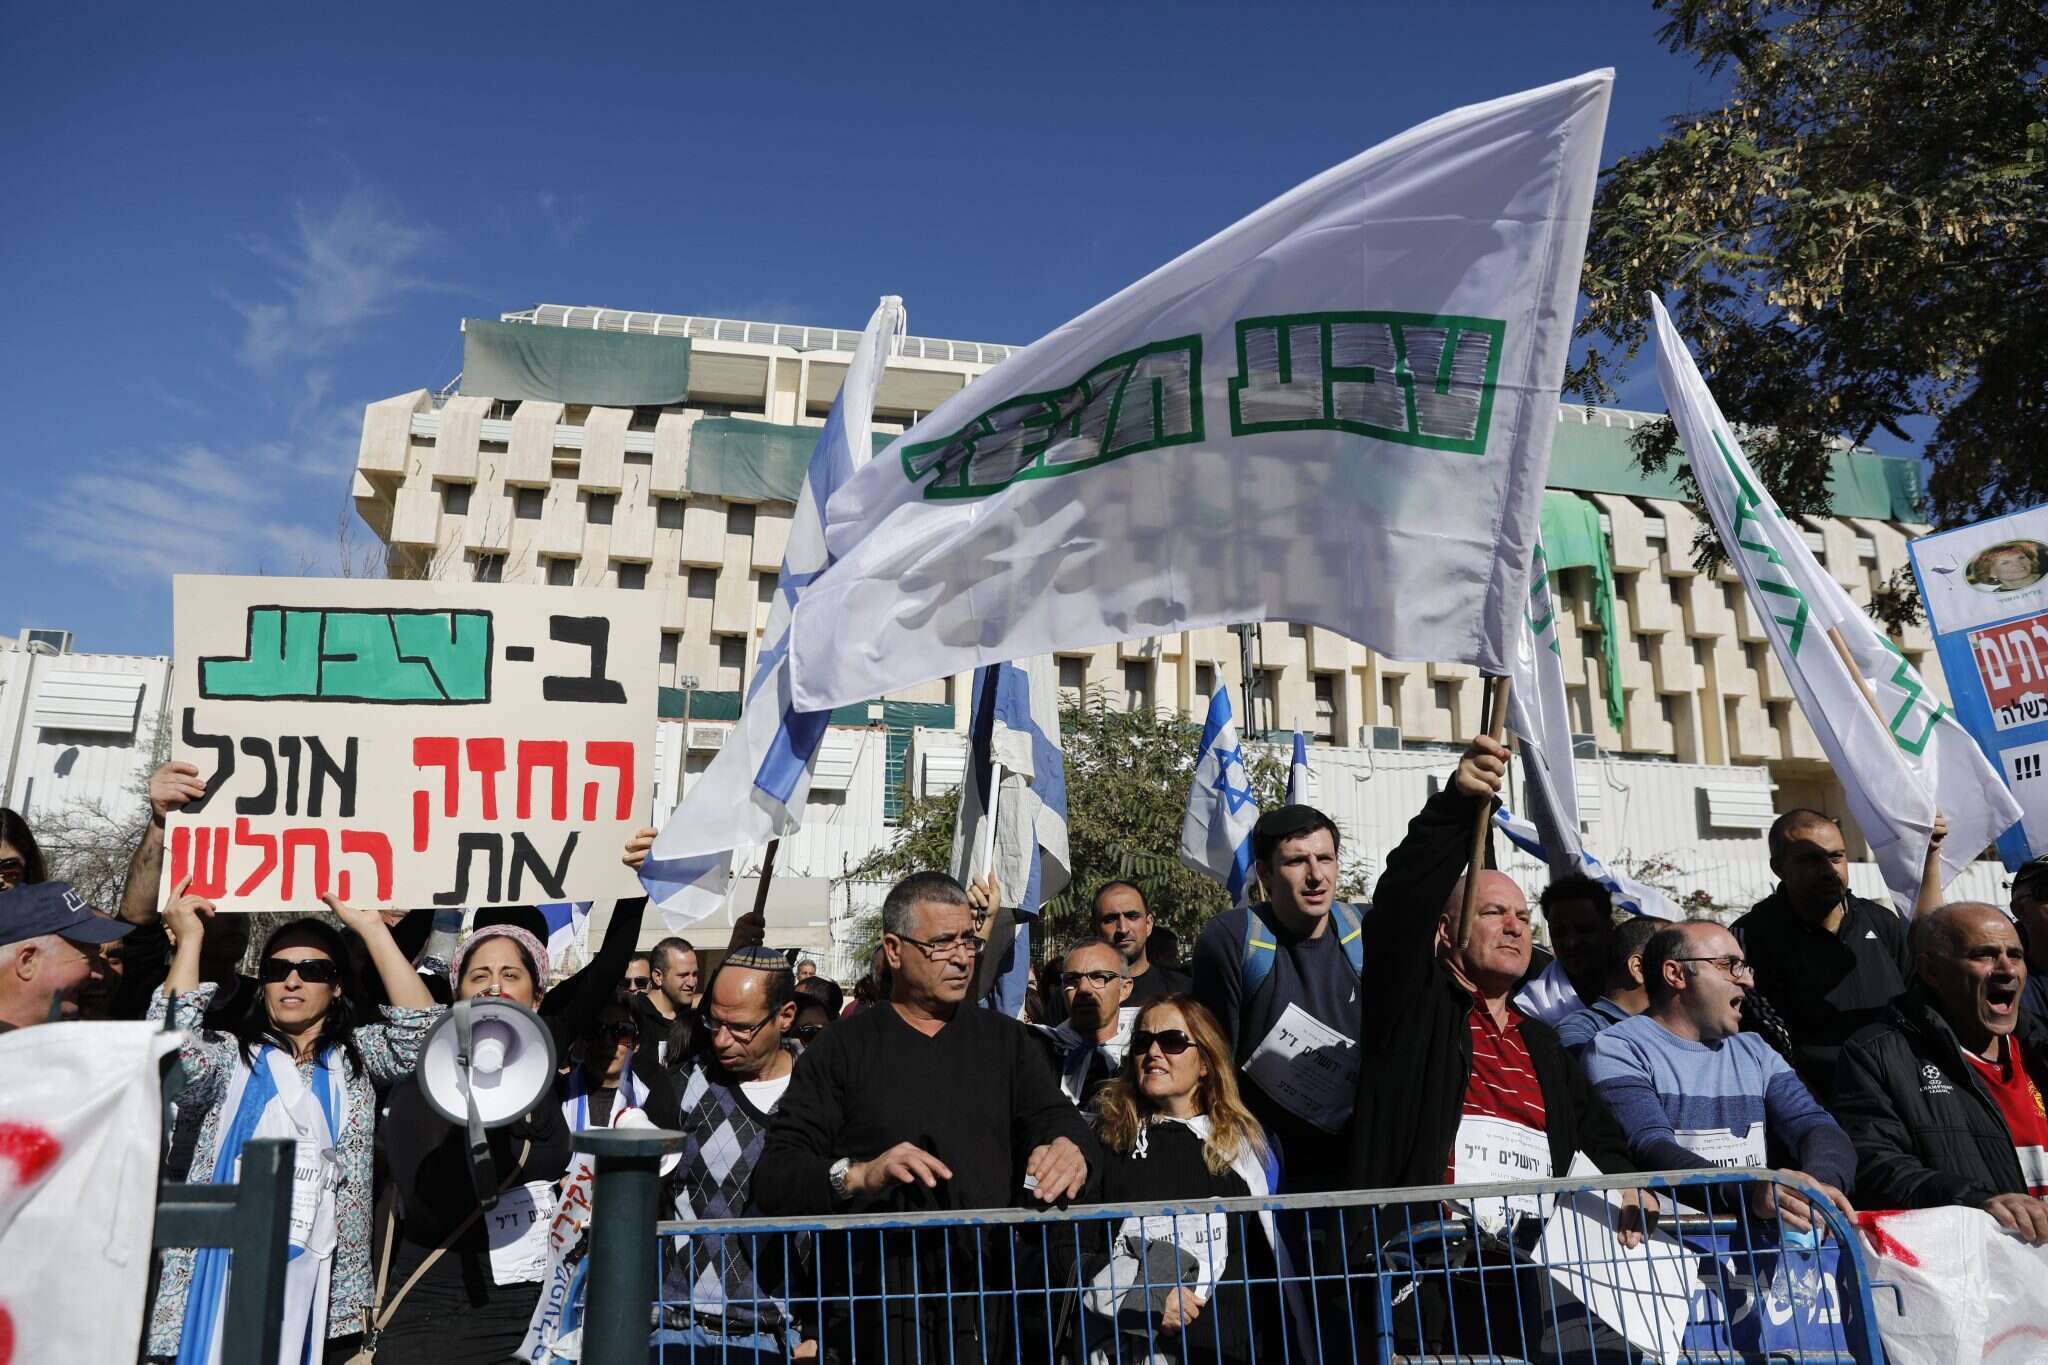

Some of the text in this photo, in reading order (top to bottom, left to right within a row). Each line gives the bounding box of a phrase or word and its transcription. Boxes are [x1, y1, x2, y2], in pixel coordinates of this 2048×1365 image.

[182, 707, 635, 852] החזק אוכל
[171, 817, 580, 905] את החלש
[1465, 1143, 1487, 1161] ז"ל
[1499, 1150, 1540, 1173] ירושלים
[495, 1211, 518, 1230] ז"ל
